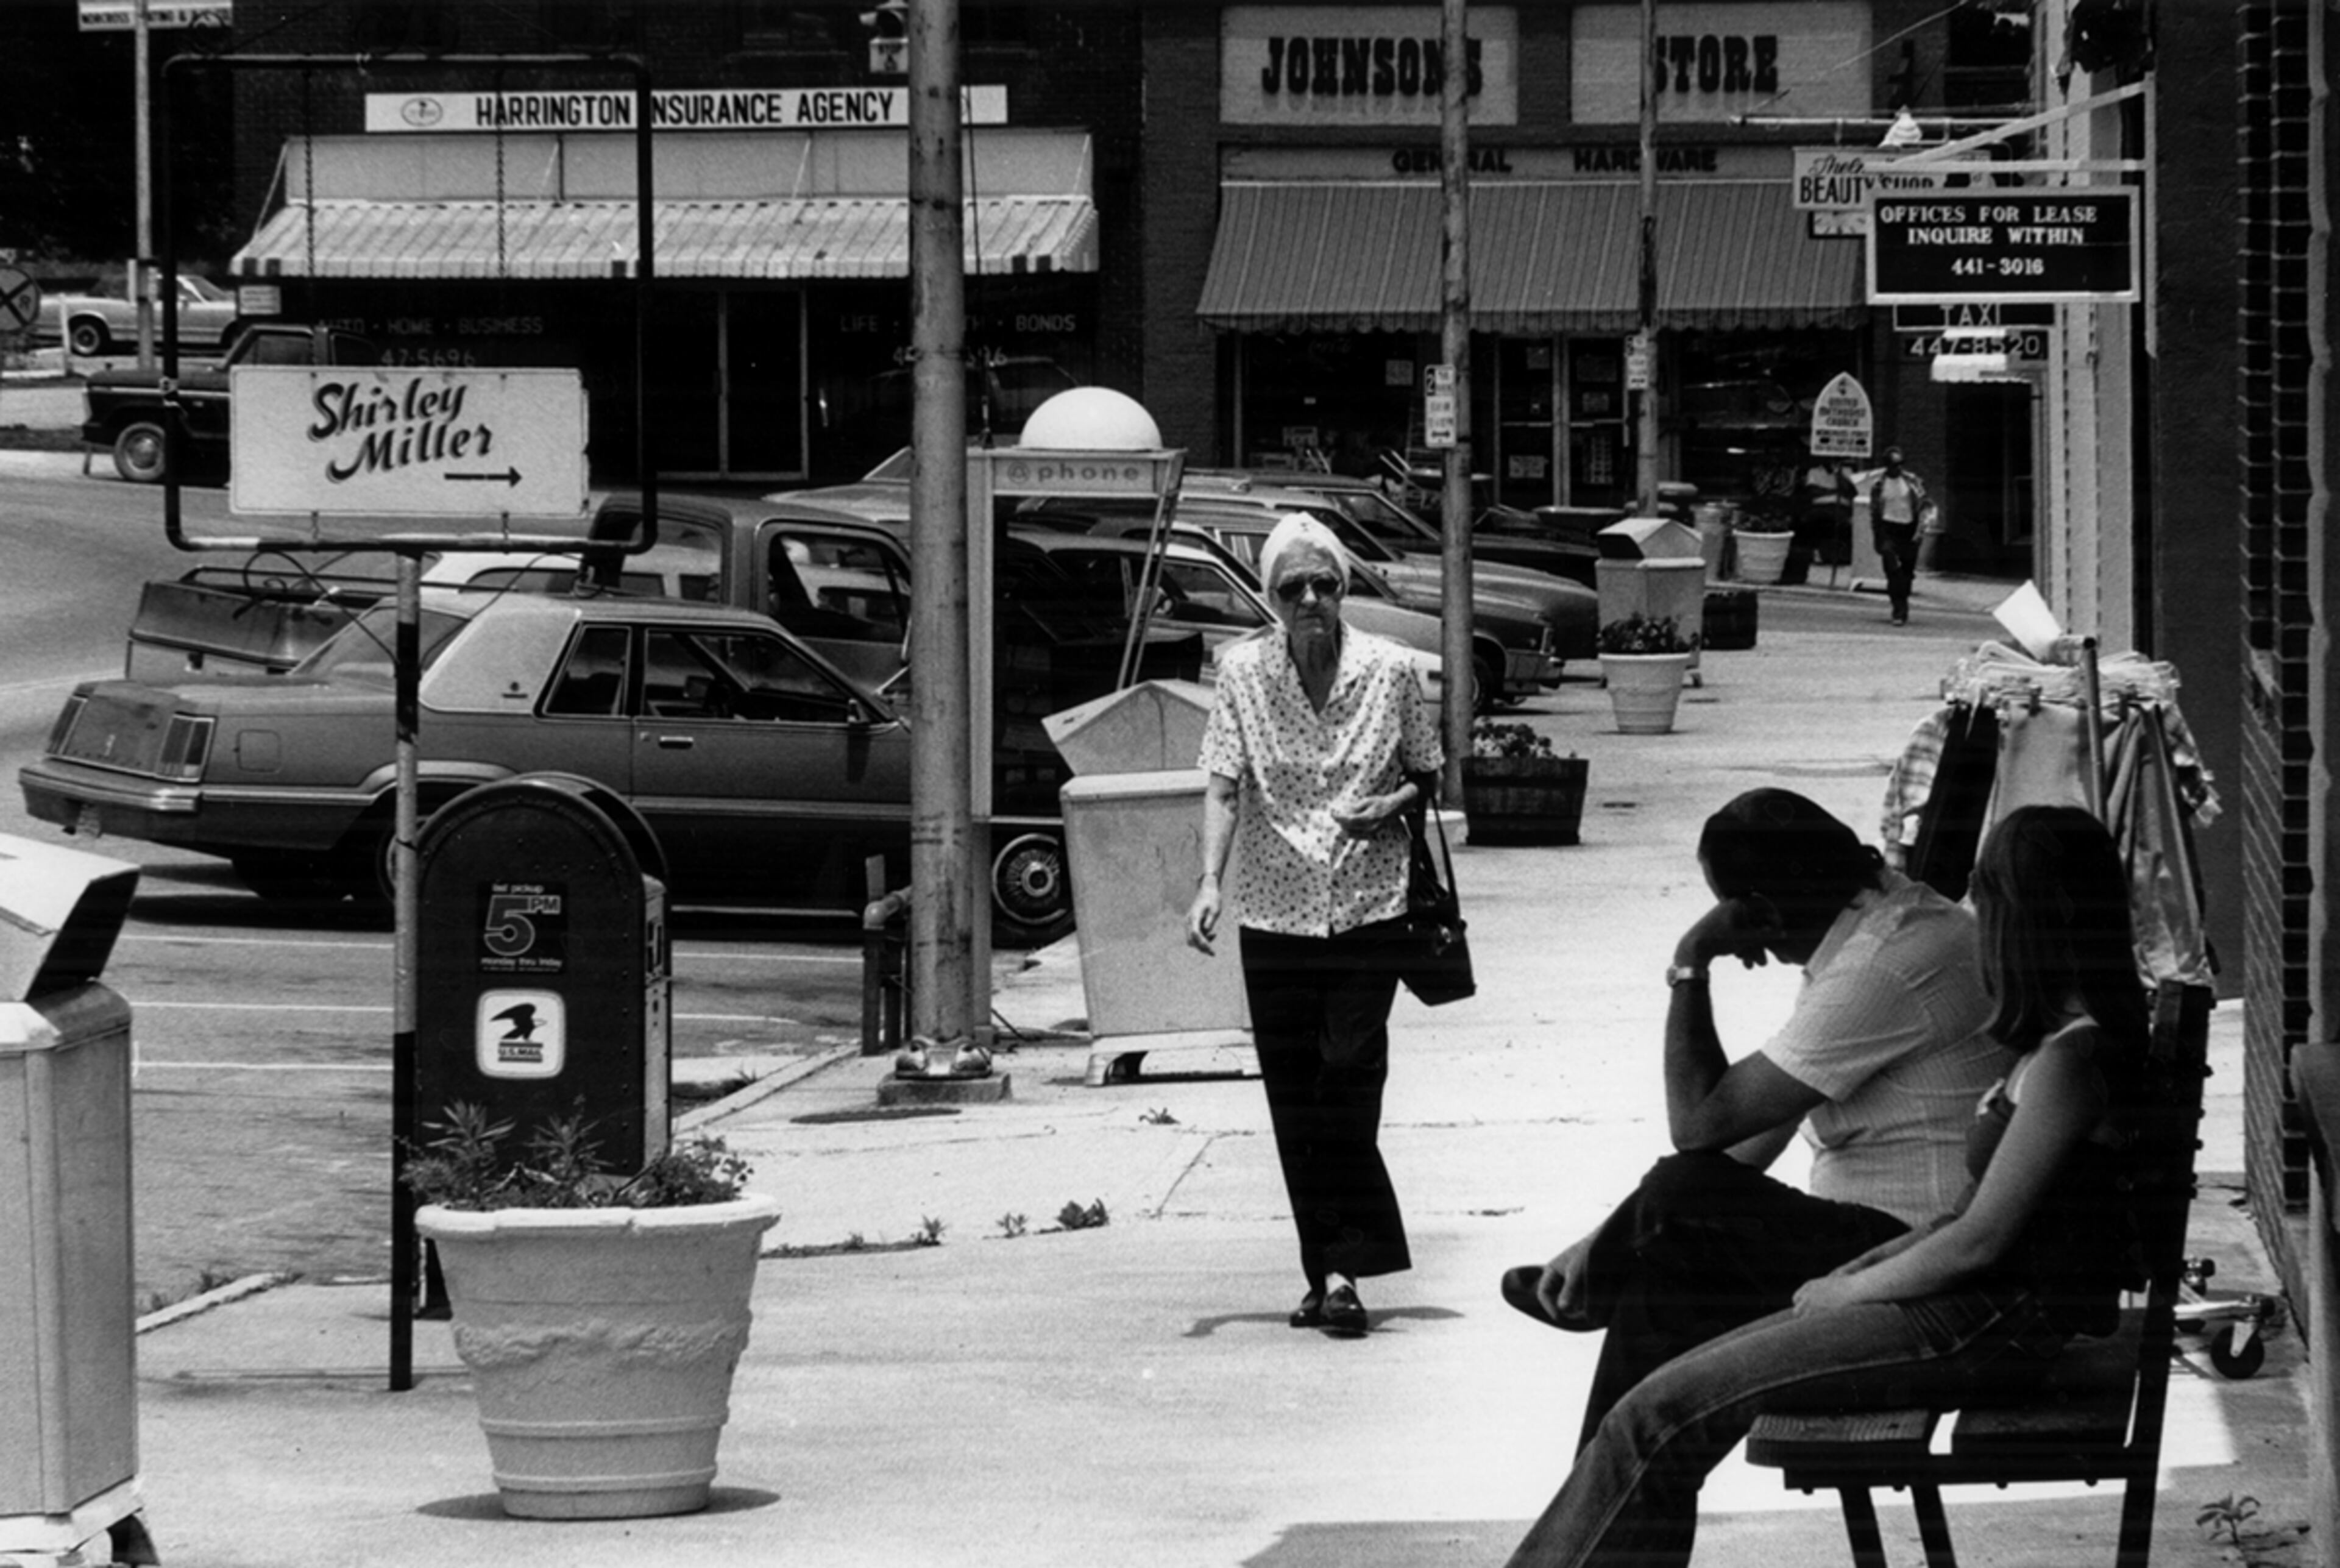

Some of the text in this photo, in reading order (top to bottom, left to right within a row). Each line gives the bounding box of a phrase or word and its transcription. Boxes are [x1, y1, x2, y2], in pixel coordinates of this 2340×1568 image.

[476, 91, 893, 126] HARRINGTON NSURANCE AGENCY
[1392, 149, 1513, 173] GENRAL
[1880, 205, 2097, 224] OFFICES FOR LEASE
[1907, 226, 2084, 245] INQUIRE WITHIN
[1951, 257, 2044, 275] 441-3016
[386, 318, 432, 335] HOME
[458, 317, 544, 335] BUSINESS
[840, 313, 1076, 333] LIFE BONDS
[1910, 336, 2041, 357] 447-8520
[307, 377, 468, 442] Shirley
[326, 420, 493, 483] Miller
[1037, 462, 1140, 483] phone
[511, 884, 545, 895] pickup
[483, 894, 561, 957] 5 PM
[481, 957, 516, 967] monday
